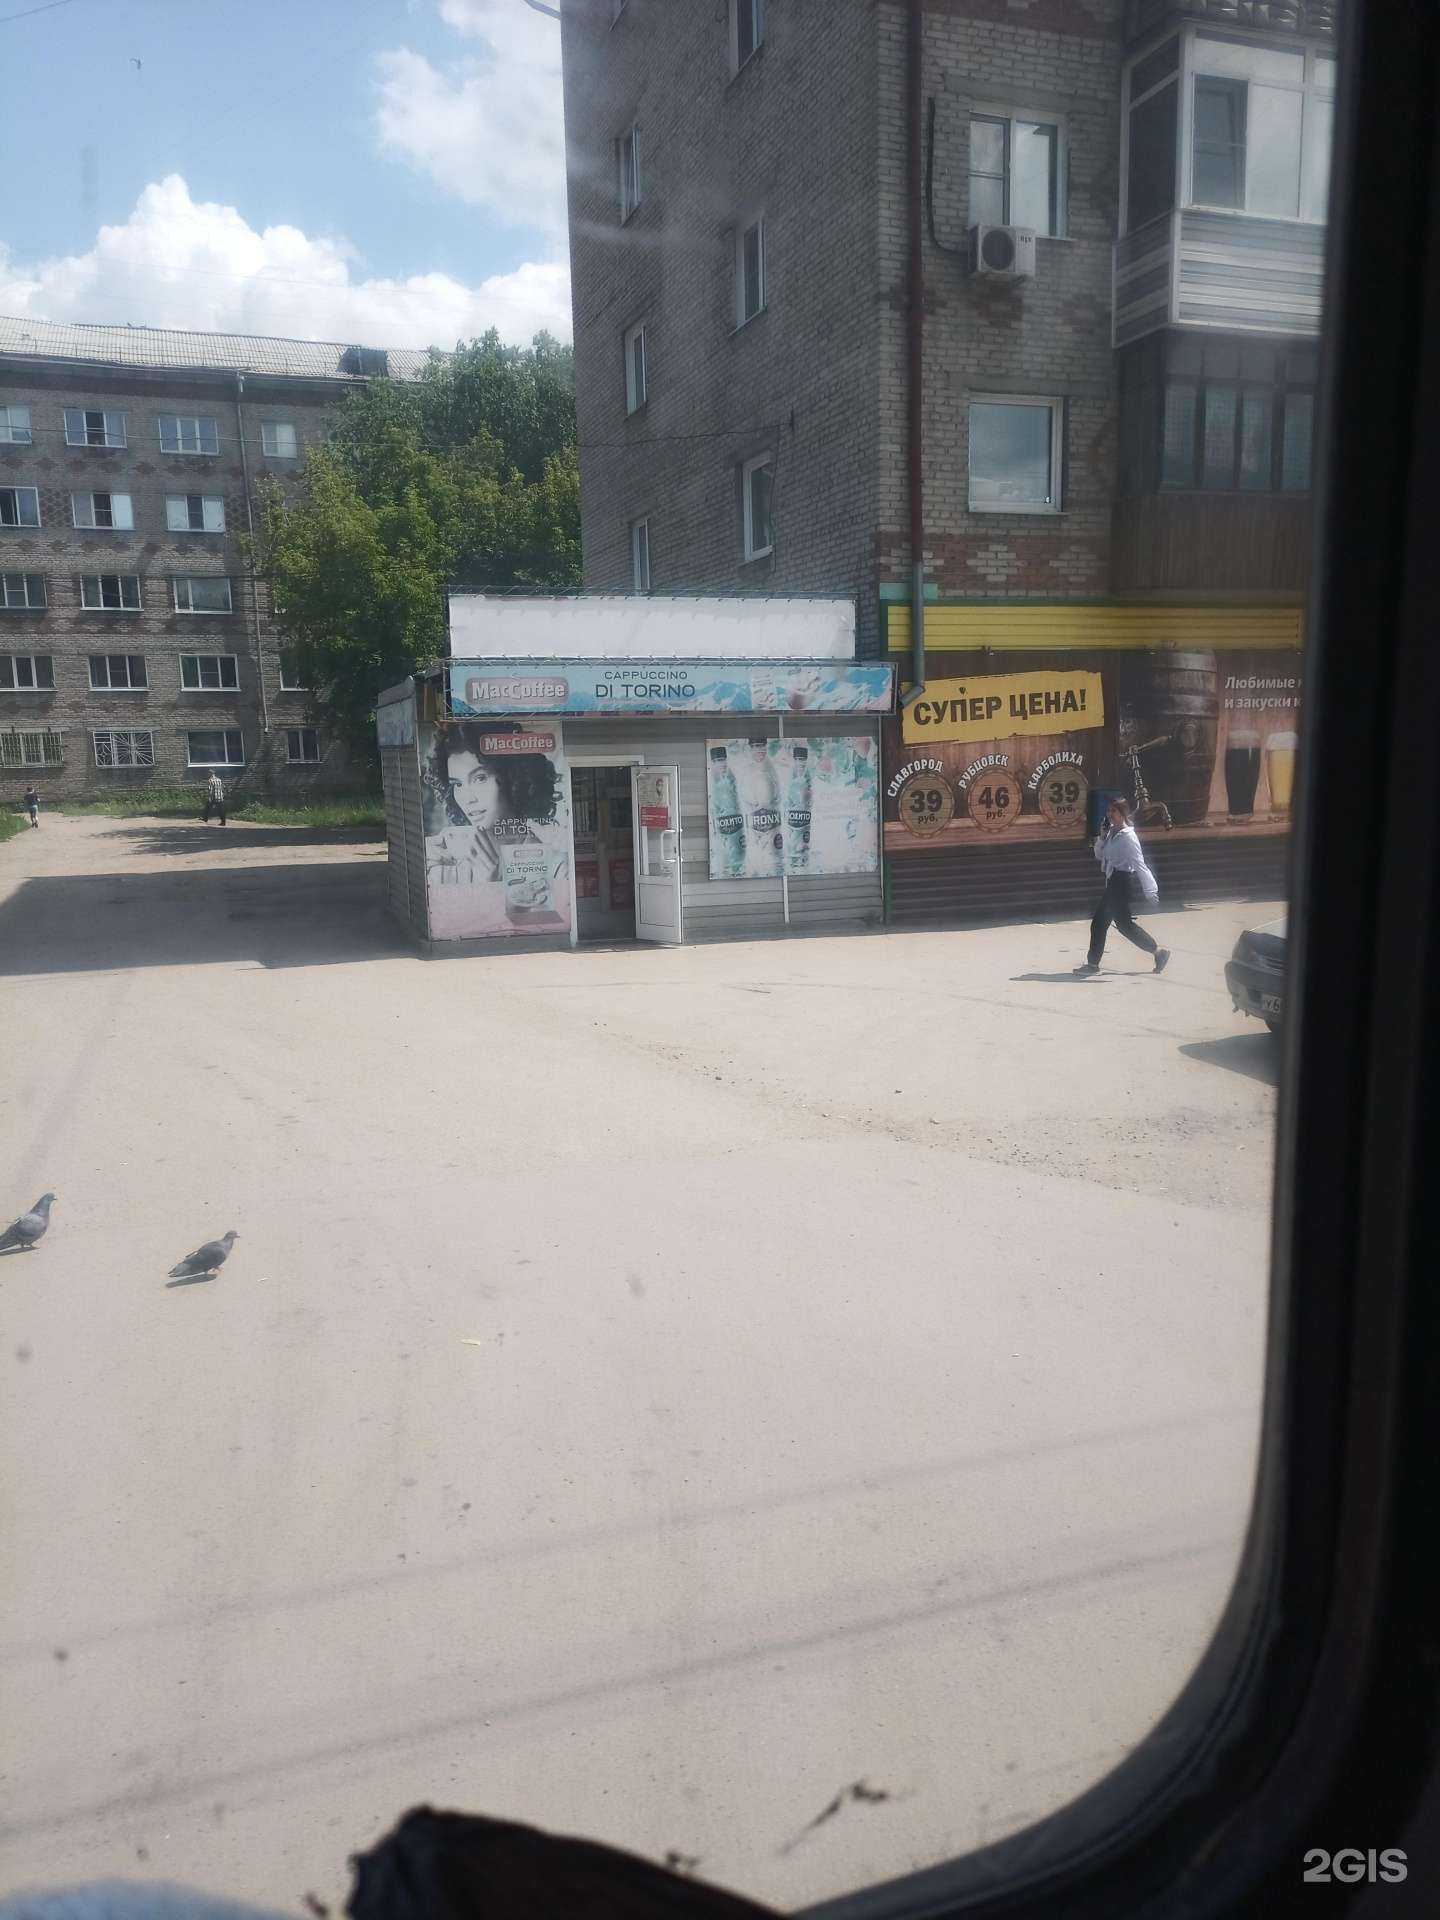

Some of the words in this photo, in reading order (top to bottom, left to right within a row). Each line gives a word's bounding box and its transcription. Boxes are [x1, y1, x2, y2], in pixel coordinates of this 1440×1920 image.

[604, 671, 688, 680] CAPPUCCINO
[1225, 676, 1296, 689] Любимые
[472, 681, 566, 699] MacCoffee
[596, 684, 613, 698] DI
[621, 684, 696, 698] TORINO
[914, 696, 1003, 726] СУПЕР
[1009, 689, 1087, 720] ЦЕНА!
[1224, 698, 1234, 709] и
[1235, 697, 1292, 712] закуски
[484, 736, 553, 751] MacCoffee
[887, 758, 944, 798] СЛАВГОРОД
[958, 753, 1009, 790] РУБЦОВСК
[1027, 751, 1084, 790] КАРБОЛИХА
[909, 789, 943, 813] 39
[978, 786, 1010, 809] 46
[1049, 782, 1080, 804] 39
[917, 812, 938, 825] руб.
[986, 808, 1006, 820] руб.
